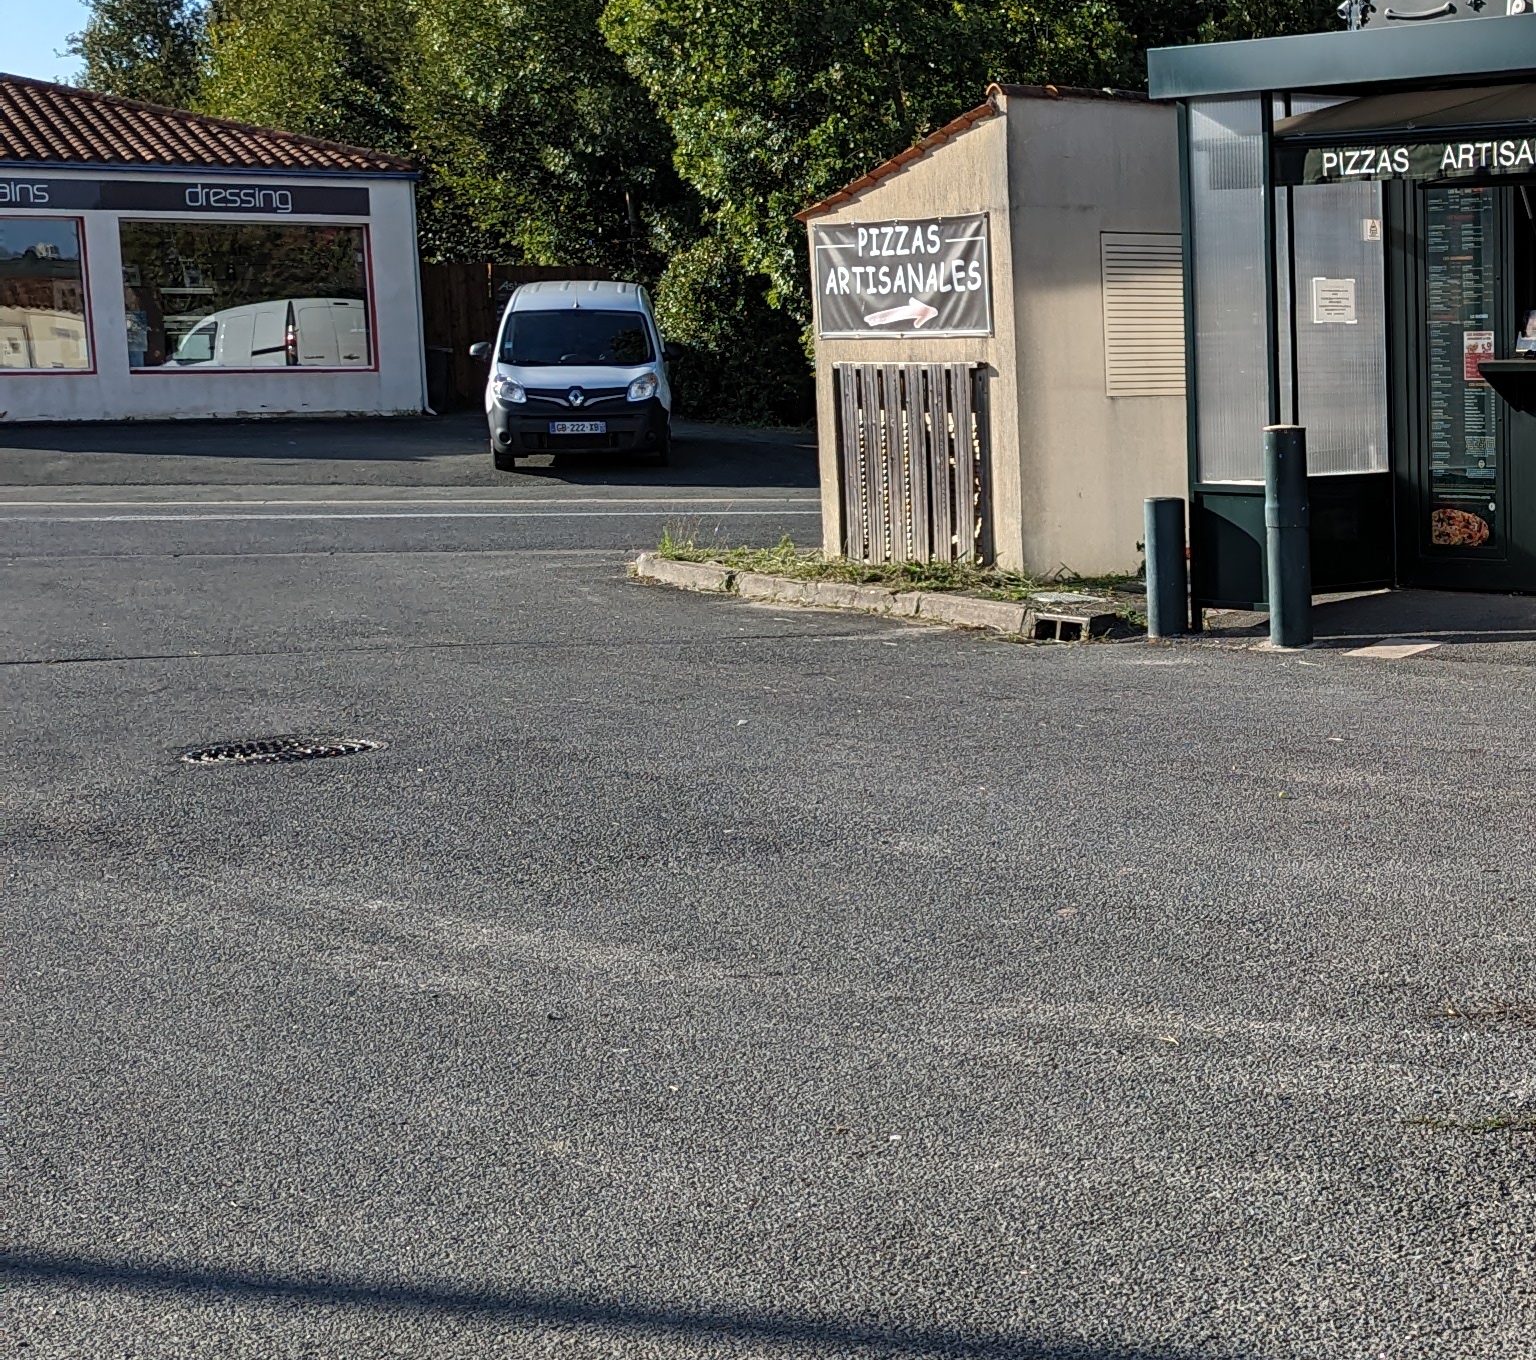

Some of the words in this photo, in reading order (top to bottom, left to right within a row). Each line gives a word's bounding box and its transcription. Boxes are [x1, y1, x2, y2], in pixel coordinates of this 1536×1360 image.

[1322, 147, 1409, 177] PIZZAS
[185, 184, 292, 213] dressing
[857, 224, 941, 257] PIZZAS
[825, 259, 982, 295] ARTISANALES
